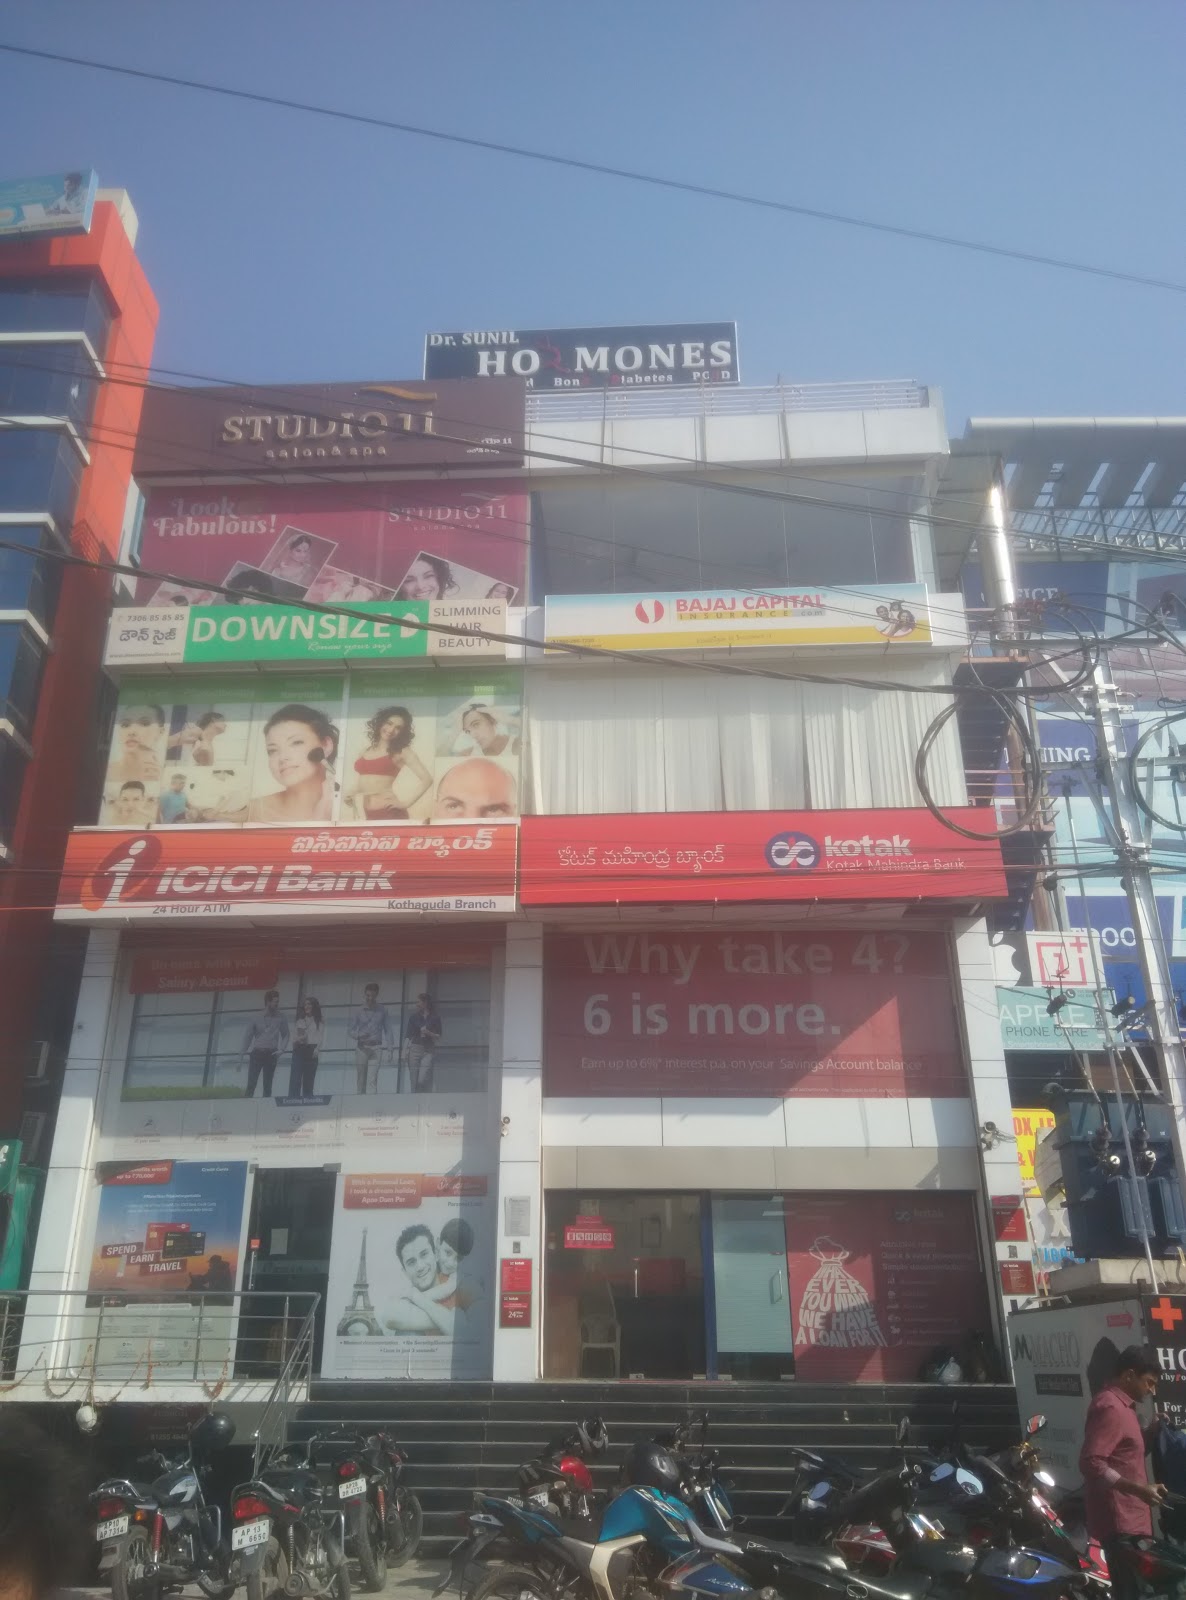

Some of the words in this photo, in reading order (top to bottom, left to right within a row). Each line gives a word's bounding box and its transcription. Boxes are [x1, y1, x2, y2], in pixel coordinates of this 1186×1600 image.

[430, 334, 456, 346] Dr.
[462, 331, 519, 344] SUNIL
[222, 411, 388, 442] STUDIO
[169, 496, 239, 519] Look
[388, 505, 481, 522] STUDIO
[153, 514, 276, 536] Fabulous!
[675, 597, 736, 612] BAJAJ
[742, 594, 824, 610] CAPITAL
[433, 606, 501, 617] SLIMMING
[680, 610, 789, 620] INSURANCE
[192, 613, 392, 642] DOWNSIZE
[438, 638, 493, 648] BEAUTY
[824, 834, 913, 857] kotak
[827, 859, 863, 871] Kotak
[868, 858, 930, 871] Mahindra
[933, 858, 967, 870] Bank
[276, 864, 397, 892] Bank
[153, 904, 169, 914] 24
[170, 904, 200, 914] Hour
[203, 903, 231, 913] ATM
[387, 899, 451, 911] Kothaguda
[455, 898, 496, 909] Branch
[583, 934, 701, 985] Why
[717, 932, 833, 974] take
[851, 934, 911, 974] 4?
[199, 975, 249, 988] Account
[584, 994, 612, 1036] 6
[632, 992, 668, 1036] is
[688, 1002, 841, 1036] more.
[1000, 1004, 1087, 1026] APPE
[1006, 1026, 1051, 1037] PHONE
[1053, 1027, 1088, 1037] CARE
[581, 1057, 605, 1069] Earn
[608, 1058, 624, 1071] up
[626, 1058, 638, 1069] to
[665, 1057, 707, 1069] interest
[730, 1060, 746, 1069] on
[748, 1060, 774, 1071] your
[780, 1058, 823, 1072] Savings
[826, 1058, 874, 1070] Account
[106, 1244, 137, 1256] SPEND
[130, 1254, 155, 1264] EARN
[148, 1261, 182, 1273] TRAVEL
[806, 1278, 867, 1293] EVER
[800, 1291, 831, 1312] YOU
[833, 1292, 873, 1312] WANT
[800, 1308, 827, 1328] WE
[832, 1308, 878, 1330] HAVE
[795, 1326, 808, 1344] A
[809, 1327, 849, 1347] LOAN
[848, 1329, 875, 1347] FOR
[1163, 1401, 1182, 1412] For
[240, 1526, 251, 1536] AP
